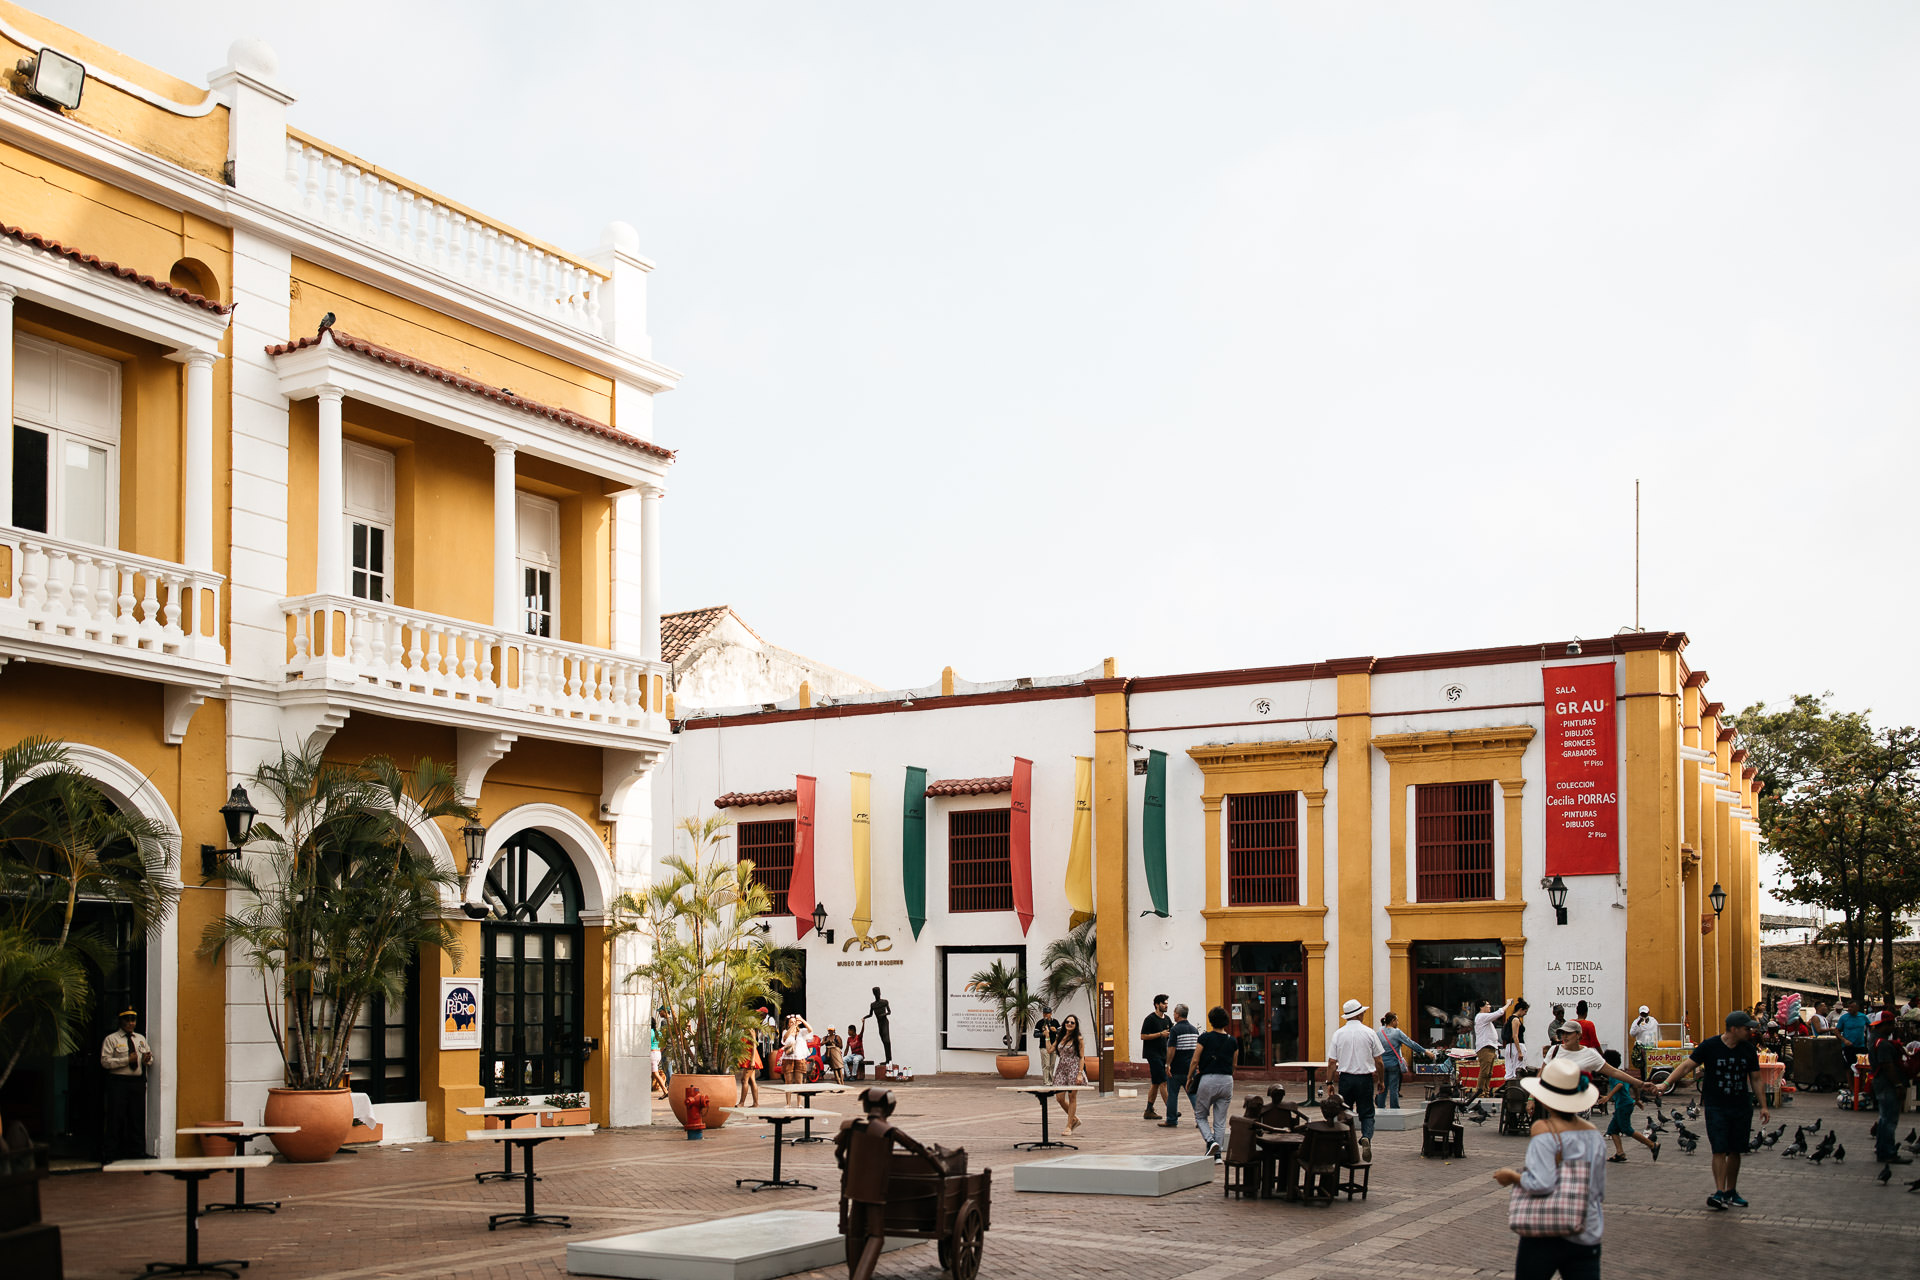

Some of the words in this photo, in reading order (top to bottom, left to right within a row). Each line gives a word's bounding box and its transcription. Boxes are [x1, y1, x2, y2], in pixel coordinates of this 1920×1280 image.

[1555, 686, 1577, 695] SALA
[1555, 699, 1605, 715] GRAU
[1563, 718, 1597, 728] PINTURAS
[1564, 728, 1594, 738] DIBUJOS
[1563, 738, 1596, 748] BRONCES
[1563, 749, 1598, 758] GRABADOS
[1556, 781, 1595, 790] COLECCION
[1546, 795, 1575, 806] Cecilia
[1577, 792, 1616, 805] PORRAS
[1563, 810, 1598, 819] PINTURAS
[1565, 820, 1595, 829] DIBUJOS
[1547, 961, 1561, 971] LA
[1566, 961, 1603, 971] TIENDA
[1572, 974, 1595, 984] DEL
[1556, 986, 1594, 996] MUSEO
[452, 992, 469, 1001] SAN
[1587, 1001, 1602, 1010] hop
